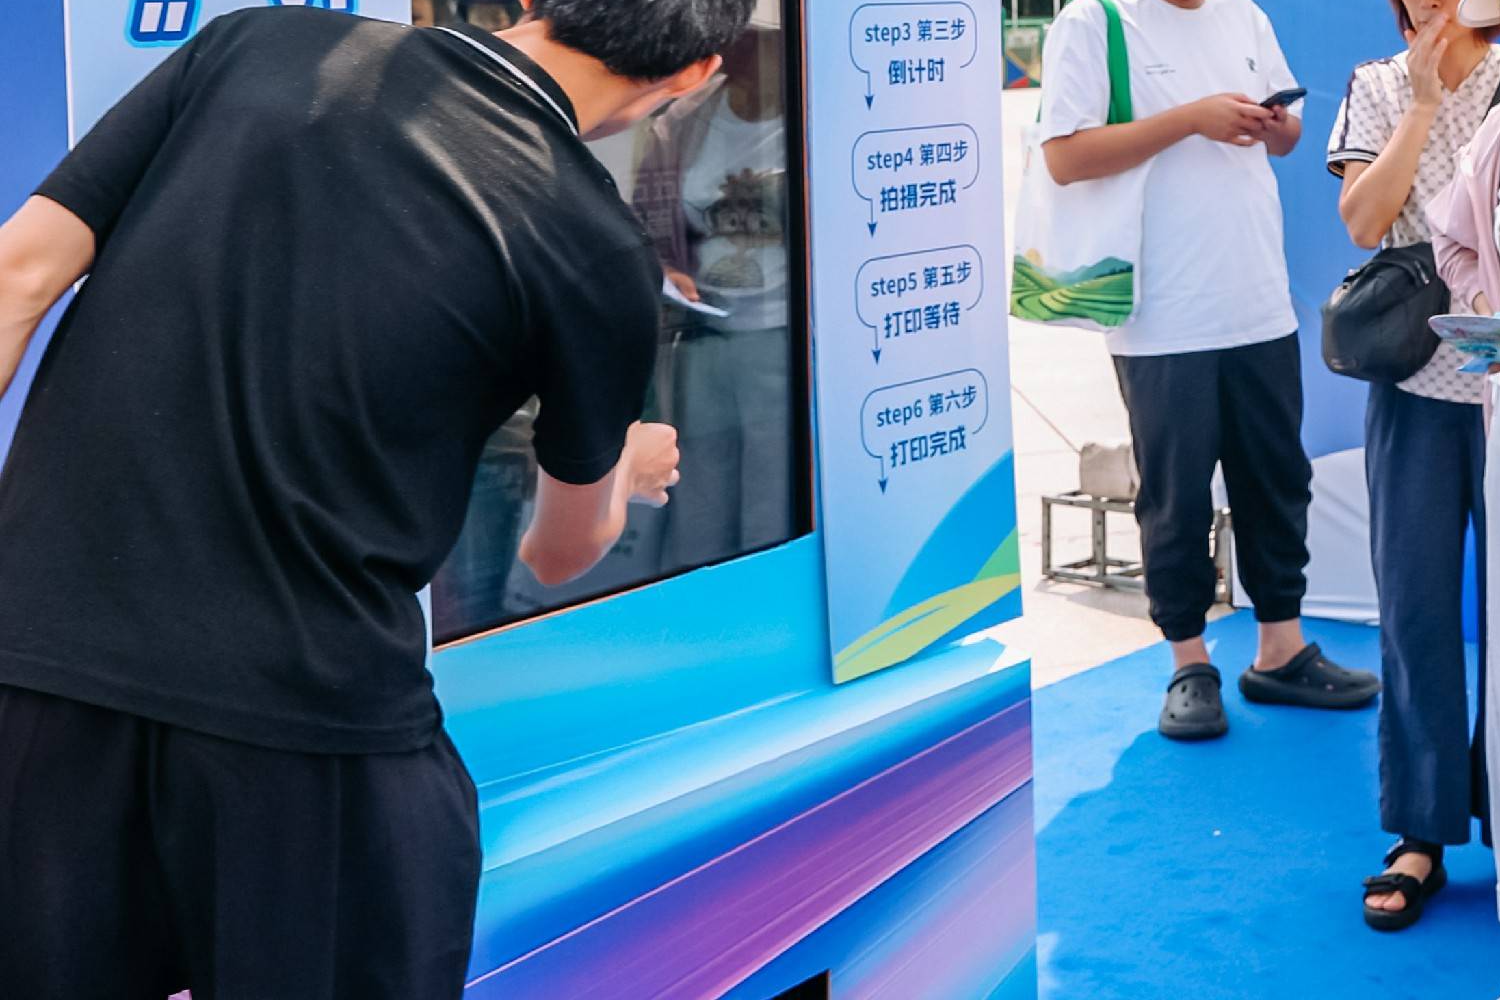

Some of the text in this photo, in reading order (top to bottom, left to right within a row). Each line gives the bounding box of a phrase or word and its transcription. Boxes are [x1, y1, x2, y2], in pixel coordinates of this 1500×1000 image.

[865, 18, 966, 46] step3 第三步
[888, 57, 946, 85] 倒计时
[867, 140, 969, 173] step4 第四步
[880, 179, 957, 213] 拍摄完成
[871, 261, 972, 298] step5 第五步
[884, 301, 961, 339] 打印等待
[877, 385, 977, 428] step6 第六步
[890, 425, 967, 468] 打印完成
